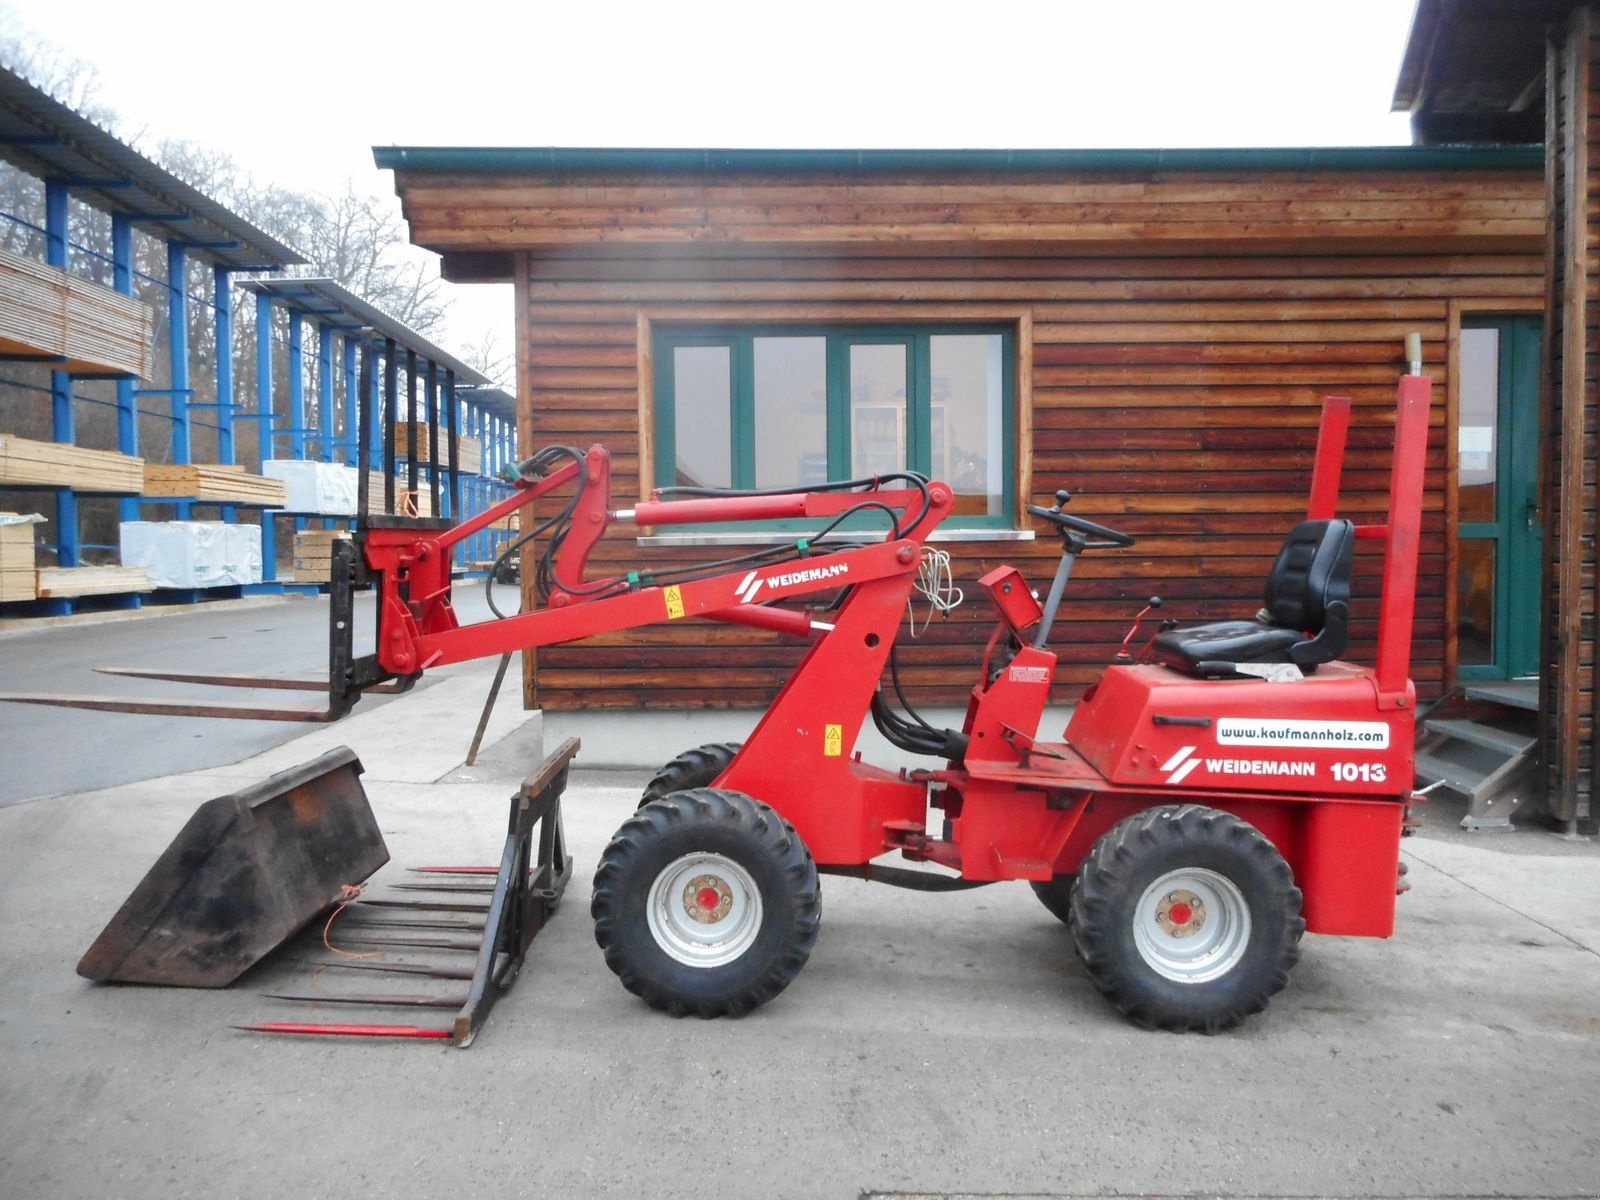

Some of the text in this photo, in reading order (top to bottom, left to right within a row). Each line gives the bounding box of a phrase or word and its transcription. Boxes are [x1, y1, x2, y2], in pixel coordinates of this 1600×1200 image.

[766, 563, 848, 588] WEIDEMANN
[1221, 726, 1384, 743] www.kaufmannholz.com
[1205, 759, 1387, 782] WEIDEMANN 1013
